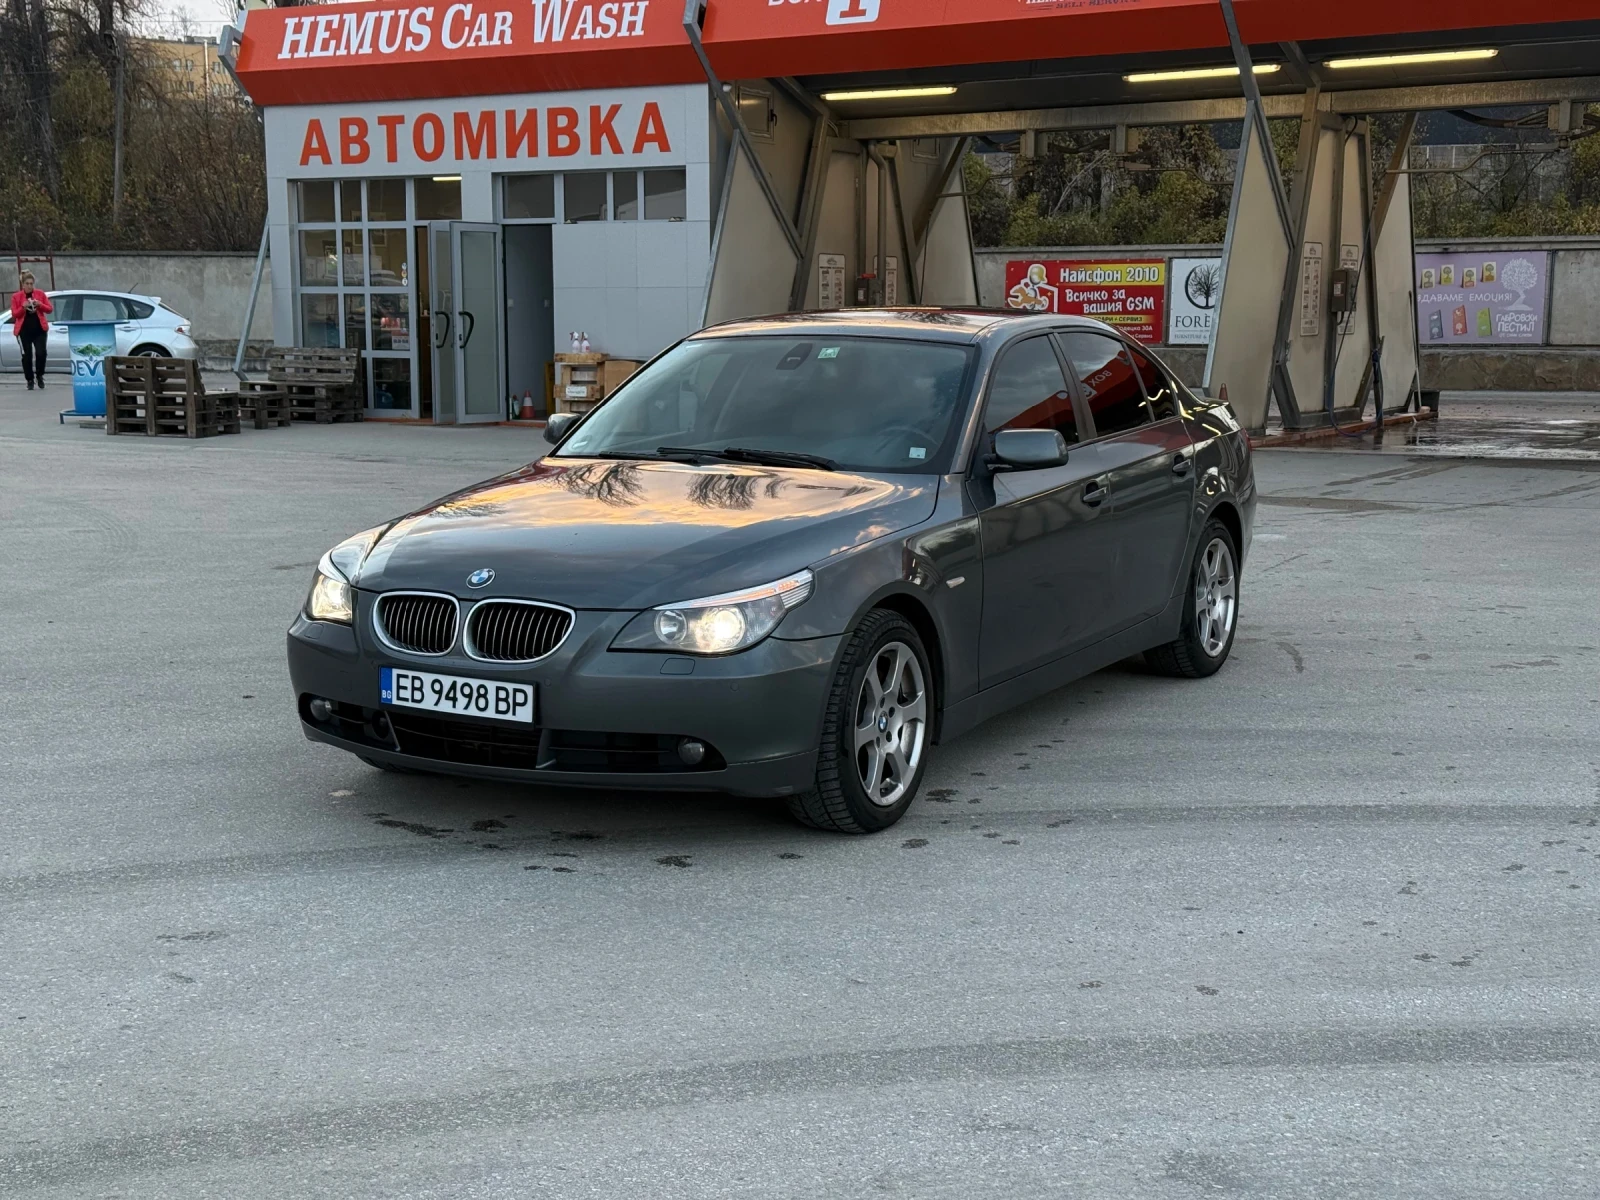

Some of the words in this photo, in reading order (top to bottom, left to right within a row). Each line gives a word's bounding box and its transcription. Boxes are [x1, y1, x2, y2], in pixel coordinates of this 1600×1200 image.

[277, 6, 435, 60] HEMUS
[441, 3, 513, 49] CAR
[532, 0, 649, 43] WASH
[300, 102, 672, 166] АВТОМИВКА
[1060, 267, 1121, 284] Найсфон
[1126, 266, 1159, 282] 2010
[1065, 289, 1108, 302] Всичко
[1112, 289, 1126, 300] за
[1469, 292, 1512, 303] ЕМОЦИЯ!
[1083, 302, 1122, 314] вашия
[1126, 296, 1154, 311] GSM
[1498, 321, 1535, 332] ПЕСТИЛ
[381, 689, 392, 699] BG
[396, 673, 425, 704] EB
[431, 678, 489, 712] 9498
[495, 686, 528, 716] BP
